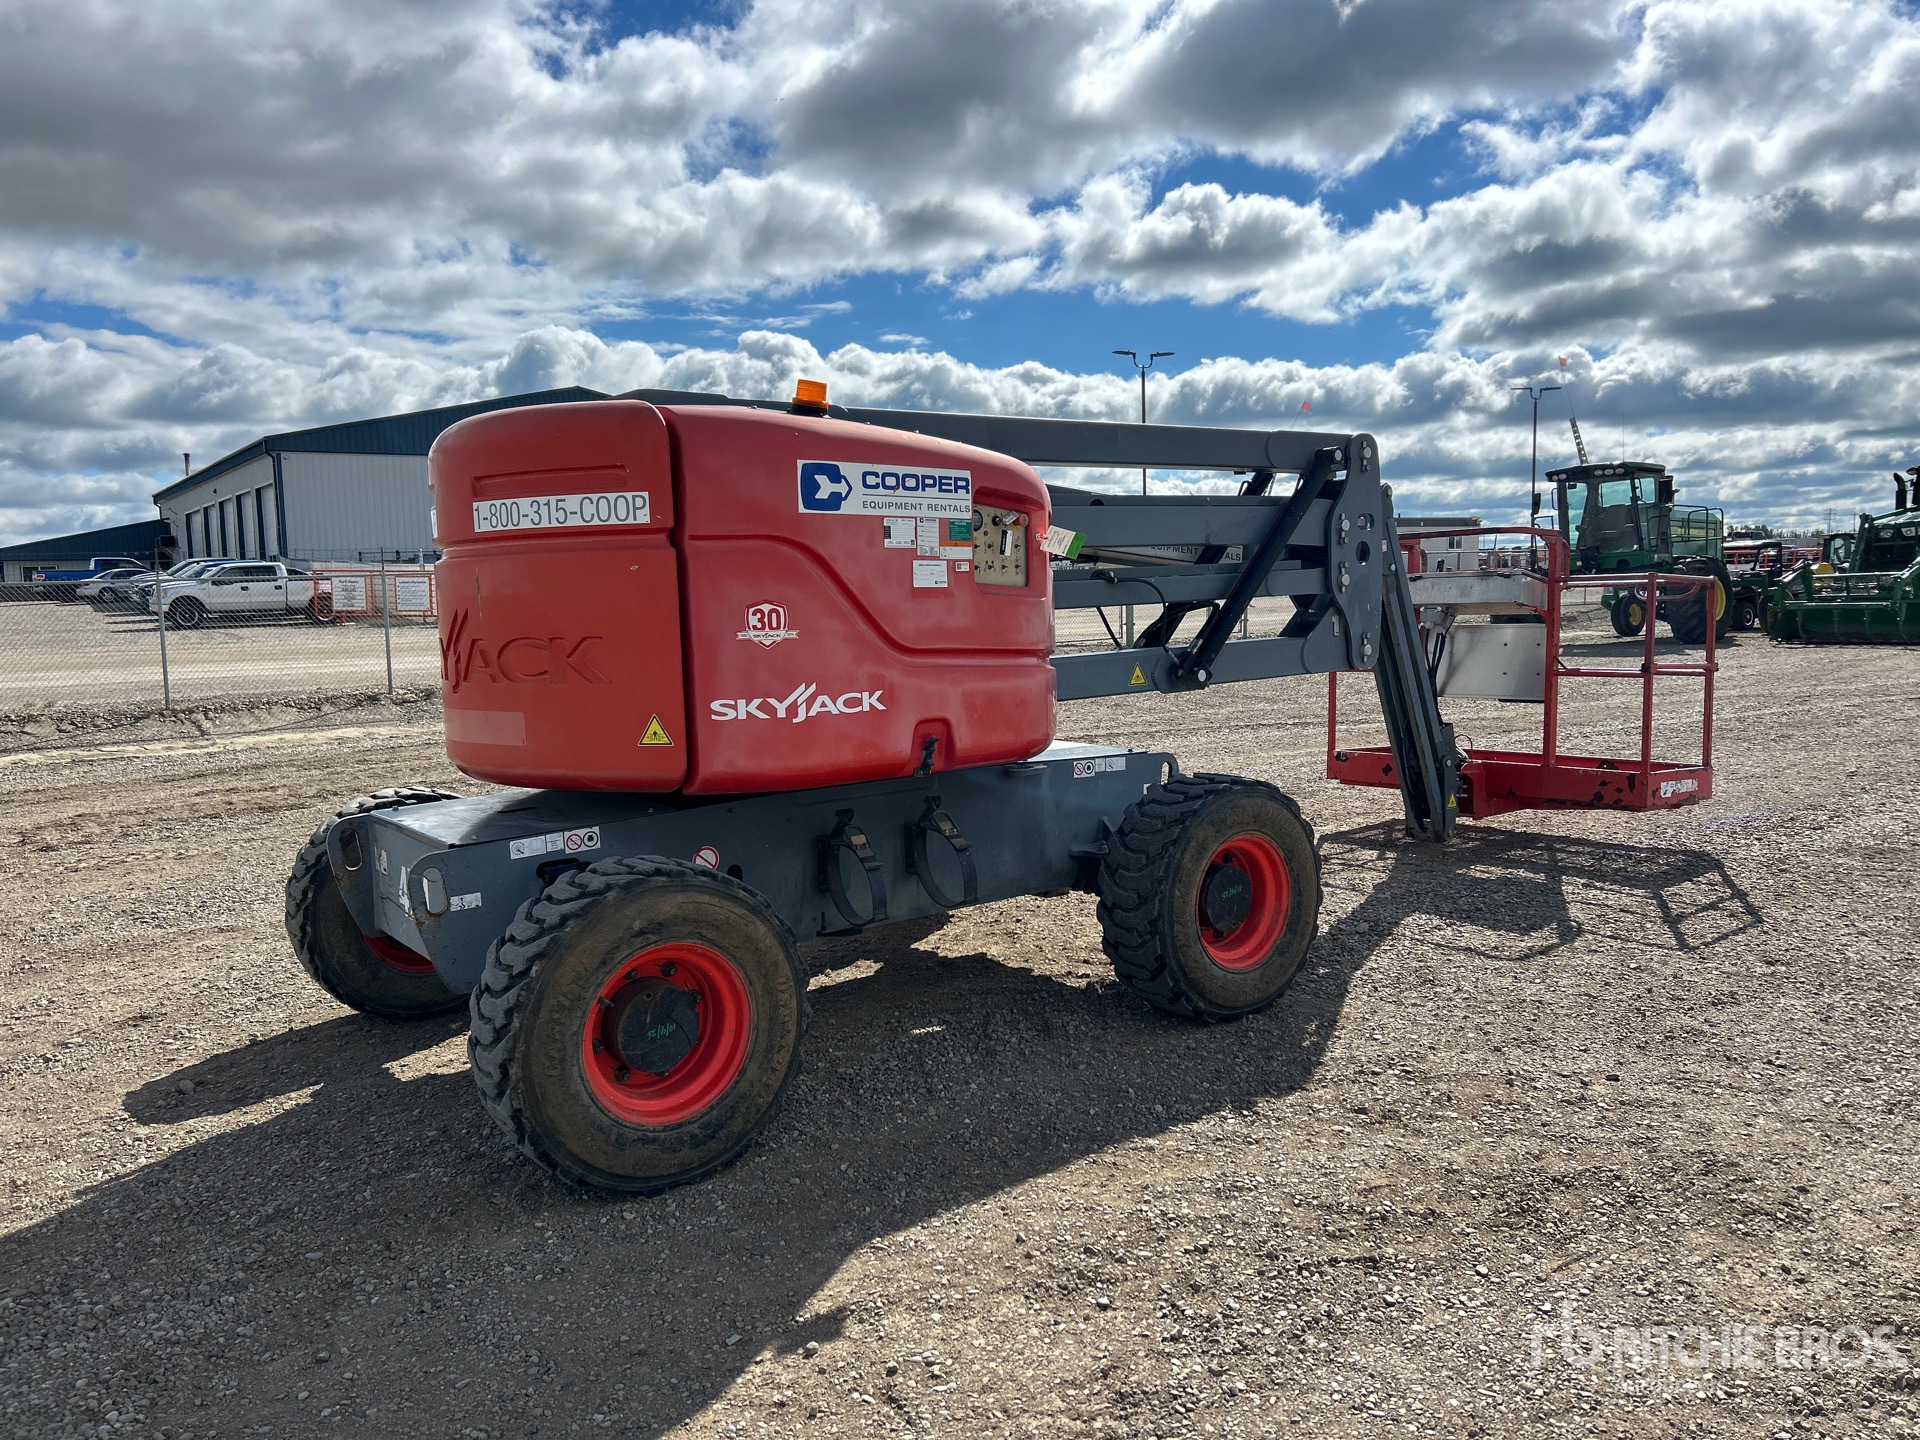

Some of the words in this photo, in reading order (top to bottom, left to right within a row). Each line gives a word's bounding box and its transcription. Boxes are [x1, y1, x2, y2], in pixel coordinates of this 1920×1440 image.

[861, 471, 970, 495] COOPER
[474, 494, 647, 530] 1-800-315-COOP
[862, 500, 924, 511] EQUIPMENT
[927, 503, 971, 513] RENTALS
[751, 608, 781, 630] 30
[440, 608, 612, 694] YJACK
[709, 682, 887, 724] SKYJACK
